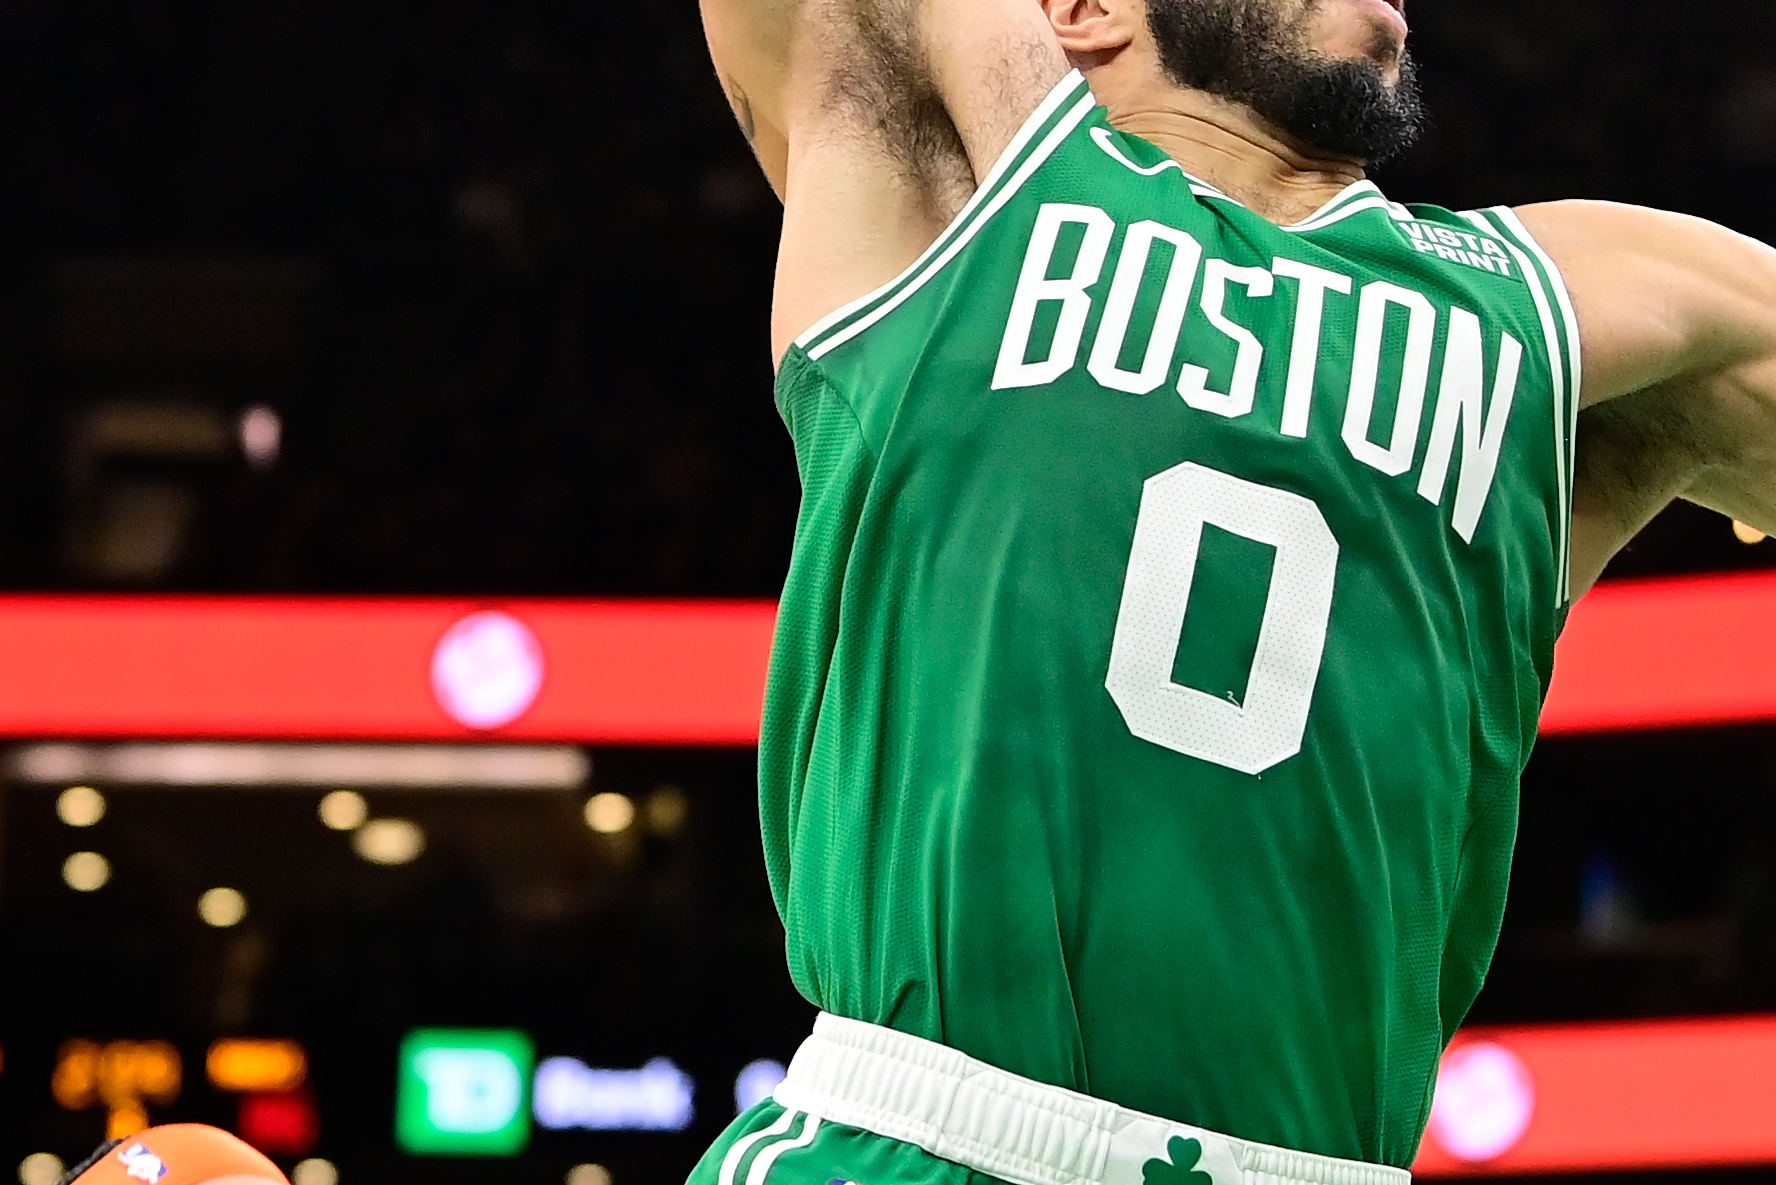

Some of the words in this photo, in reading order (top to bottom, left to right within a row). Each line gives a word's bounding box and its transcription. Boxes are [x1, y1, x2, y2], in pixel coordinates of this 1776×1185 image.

[1398, 222, 1509, 259] VISTA
[1410, 237, 1512, 277] PRINT
[991, 202, 1524, 545] BOSTON
[1104, 460, 1340, 776] 0
